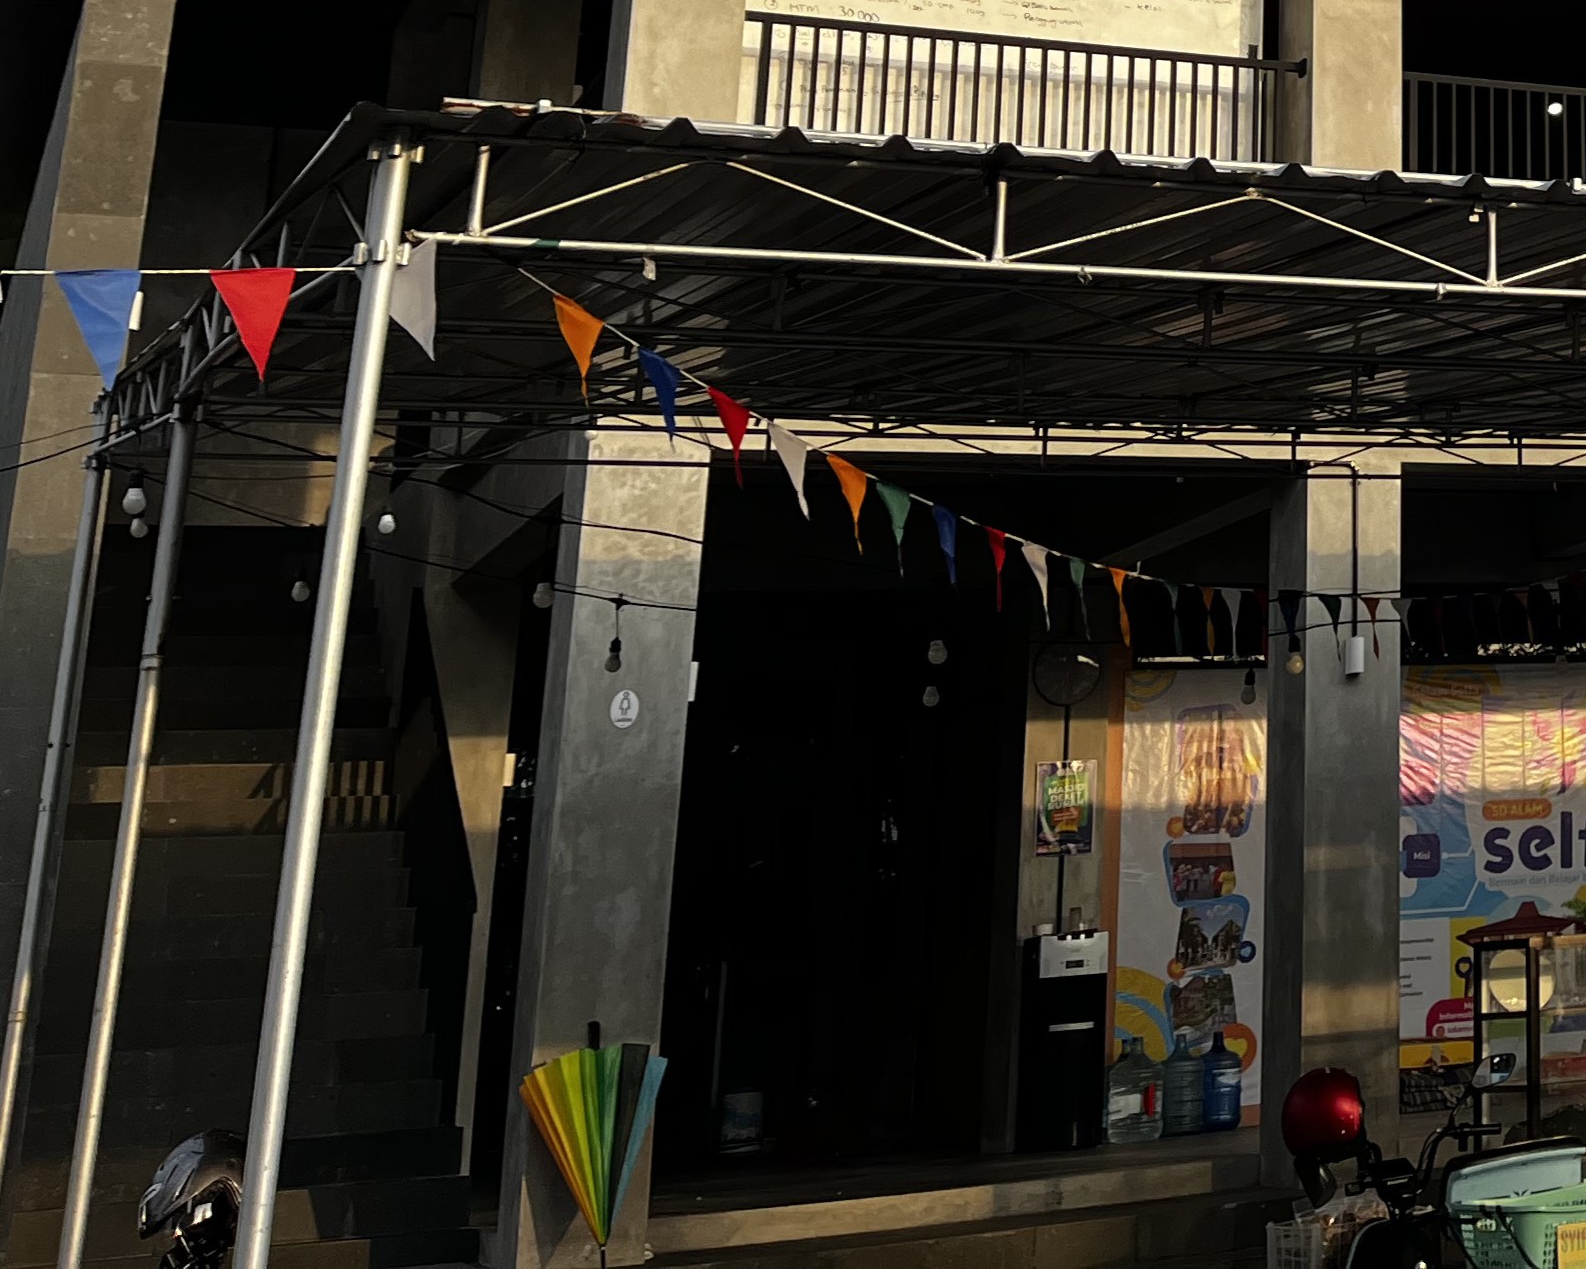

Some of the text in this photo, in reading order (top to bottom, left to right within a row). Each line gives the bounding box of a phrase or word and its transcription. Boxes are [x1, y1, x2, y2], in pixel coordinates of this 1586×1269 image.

[1492, 804, 1544, 817] SD ALAM
[1413, 851, 1432, 861] Misi
